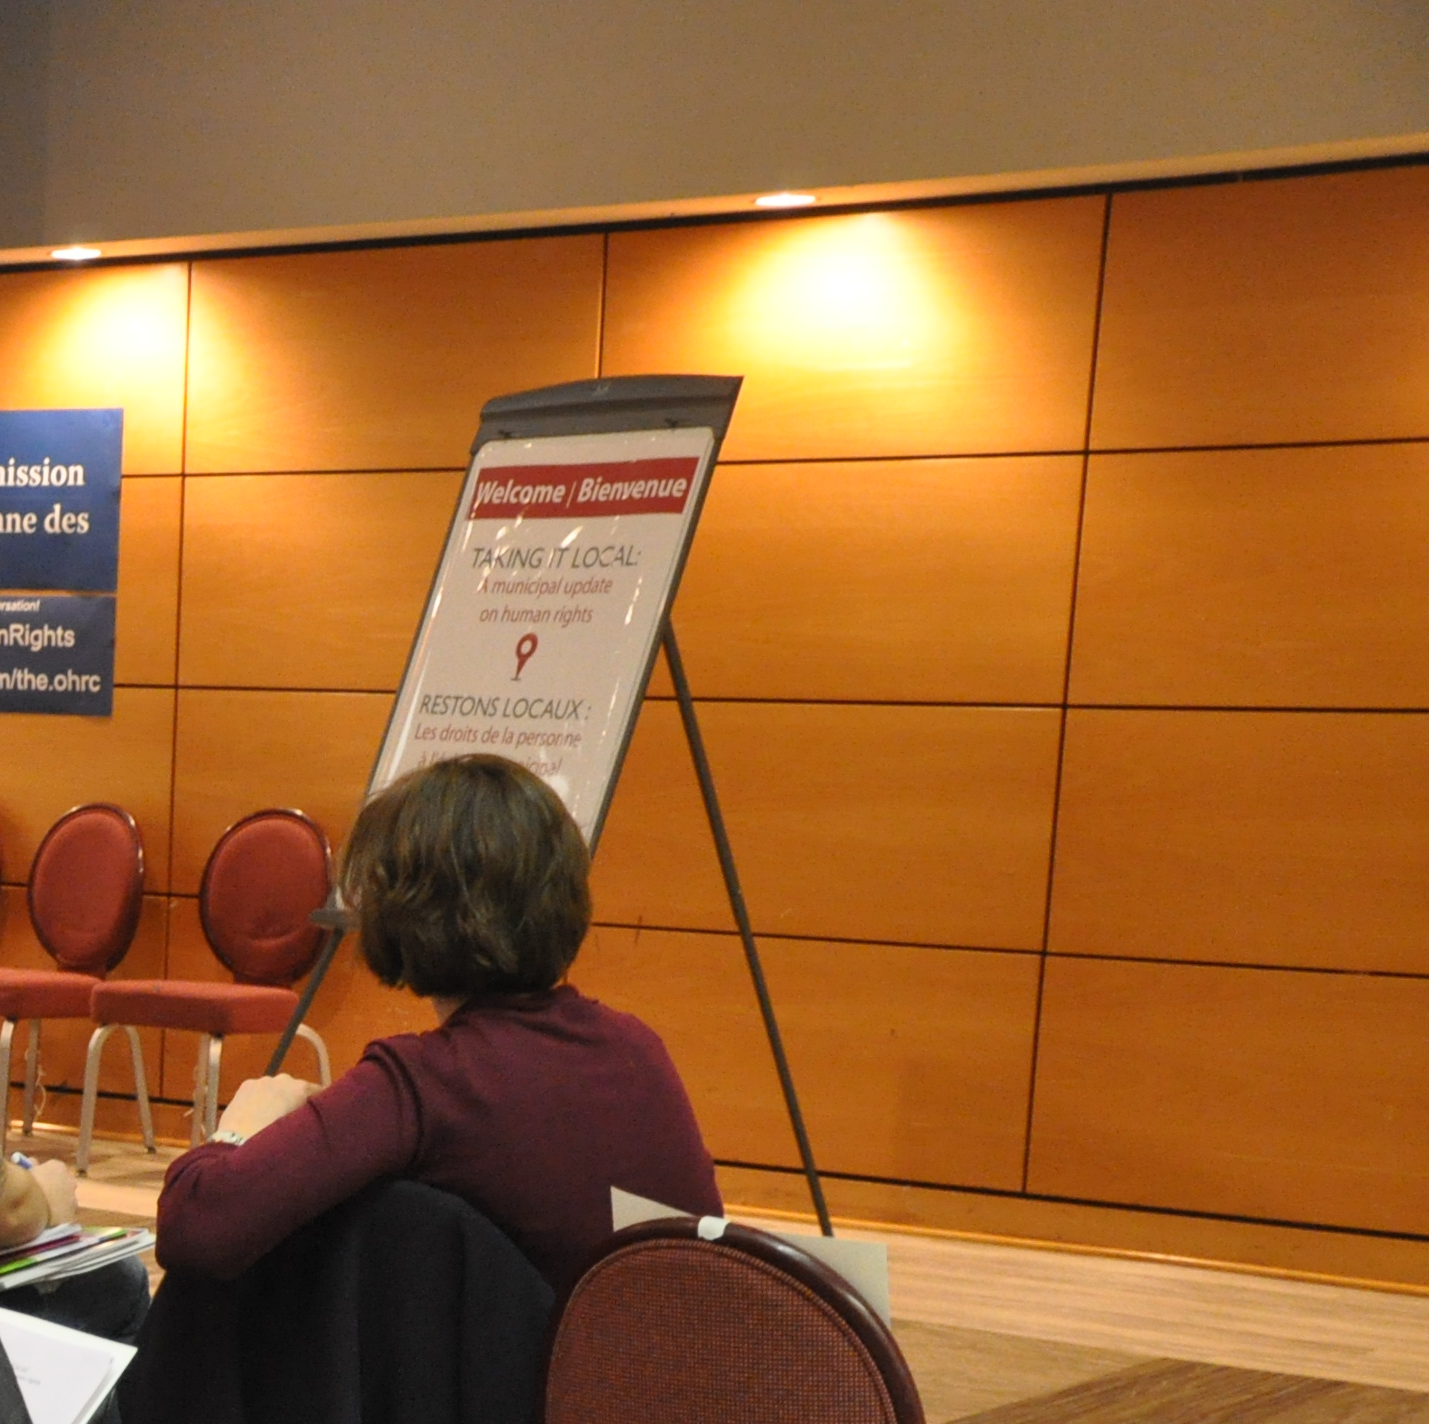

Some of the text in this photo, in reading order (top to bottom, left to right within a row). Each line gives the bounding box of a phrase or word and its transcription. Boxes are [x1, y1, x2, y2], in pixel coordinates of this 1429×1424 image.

[476, 476, 687, 508] Welcome / Bienvenue
[44, 504, 89, 534] des
[471, 545, 642, 569] TAKING IT LOCAL:
[492, 576, 564, 599] municipal
[564, 576, 613, 599] update
[479, 604, 593, 628] on human rights
[419, 695, 500, 718] RESTONS
[502, 697, 584, 720] LOCAUX
[414, 724, 582, 750] Les droits de la personne
